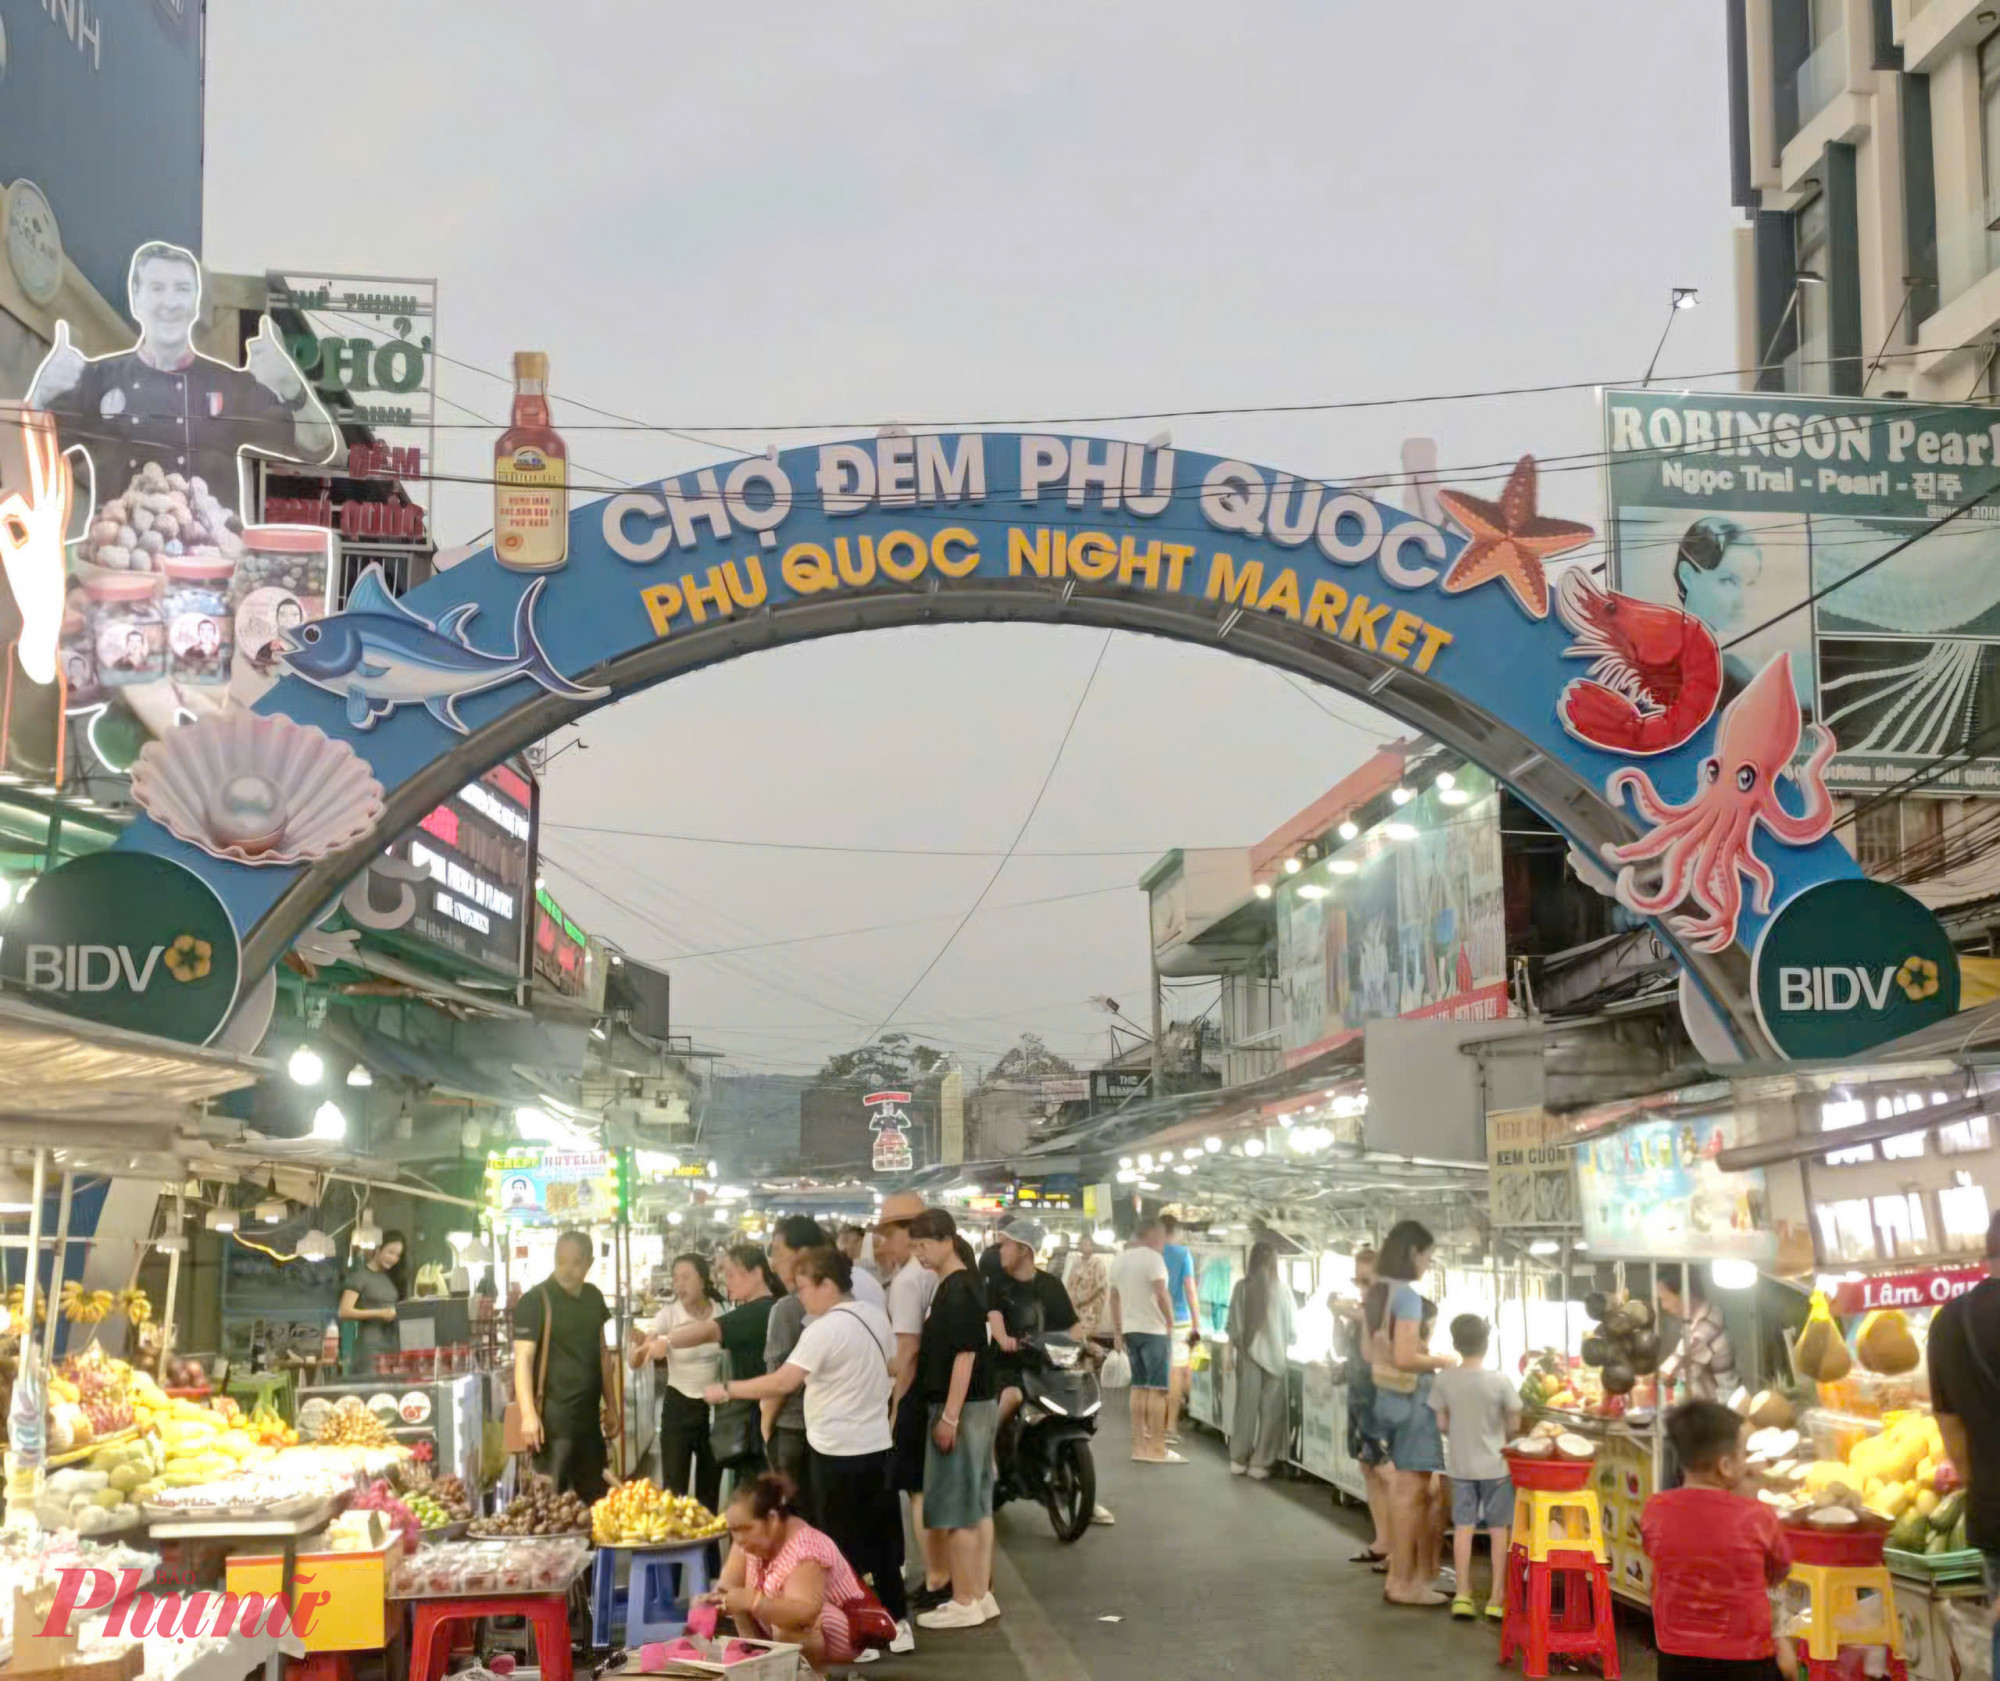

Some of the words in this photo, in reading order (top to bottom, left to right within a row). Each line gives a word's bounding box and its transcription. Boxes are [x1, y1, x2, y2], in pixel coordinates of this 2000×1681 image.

[1611, 405, 1873, 462] ROBINSON
[1887, 418, 2000, 467] Pearl
[602, 443, 792, 563] CHỢ
[1019, 429, 1175, 518] PHÚ
[1661, 460, 1736, 496] Ngọc
[640, 555, 768, 638] PHU
[780, 526, 981, 594] QUOC
[1007, 527, 1196, 593] NIGHT
[1205, 552, 1454, 676] MARKET
[26, 944, 166, 993] BIDV
[1779, 966, 1898, 1011] BIDV
[1863, 1282, 1924, 1309] Lâm
